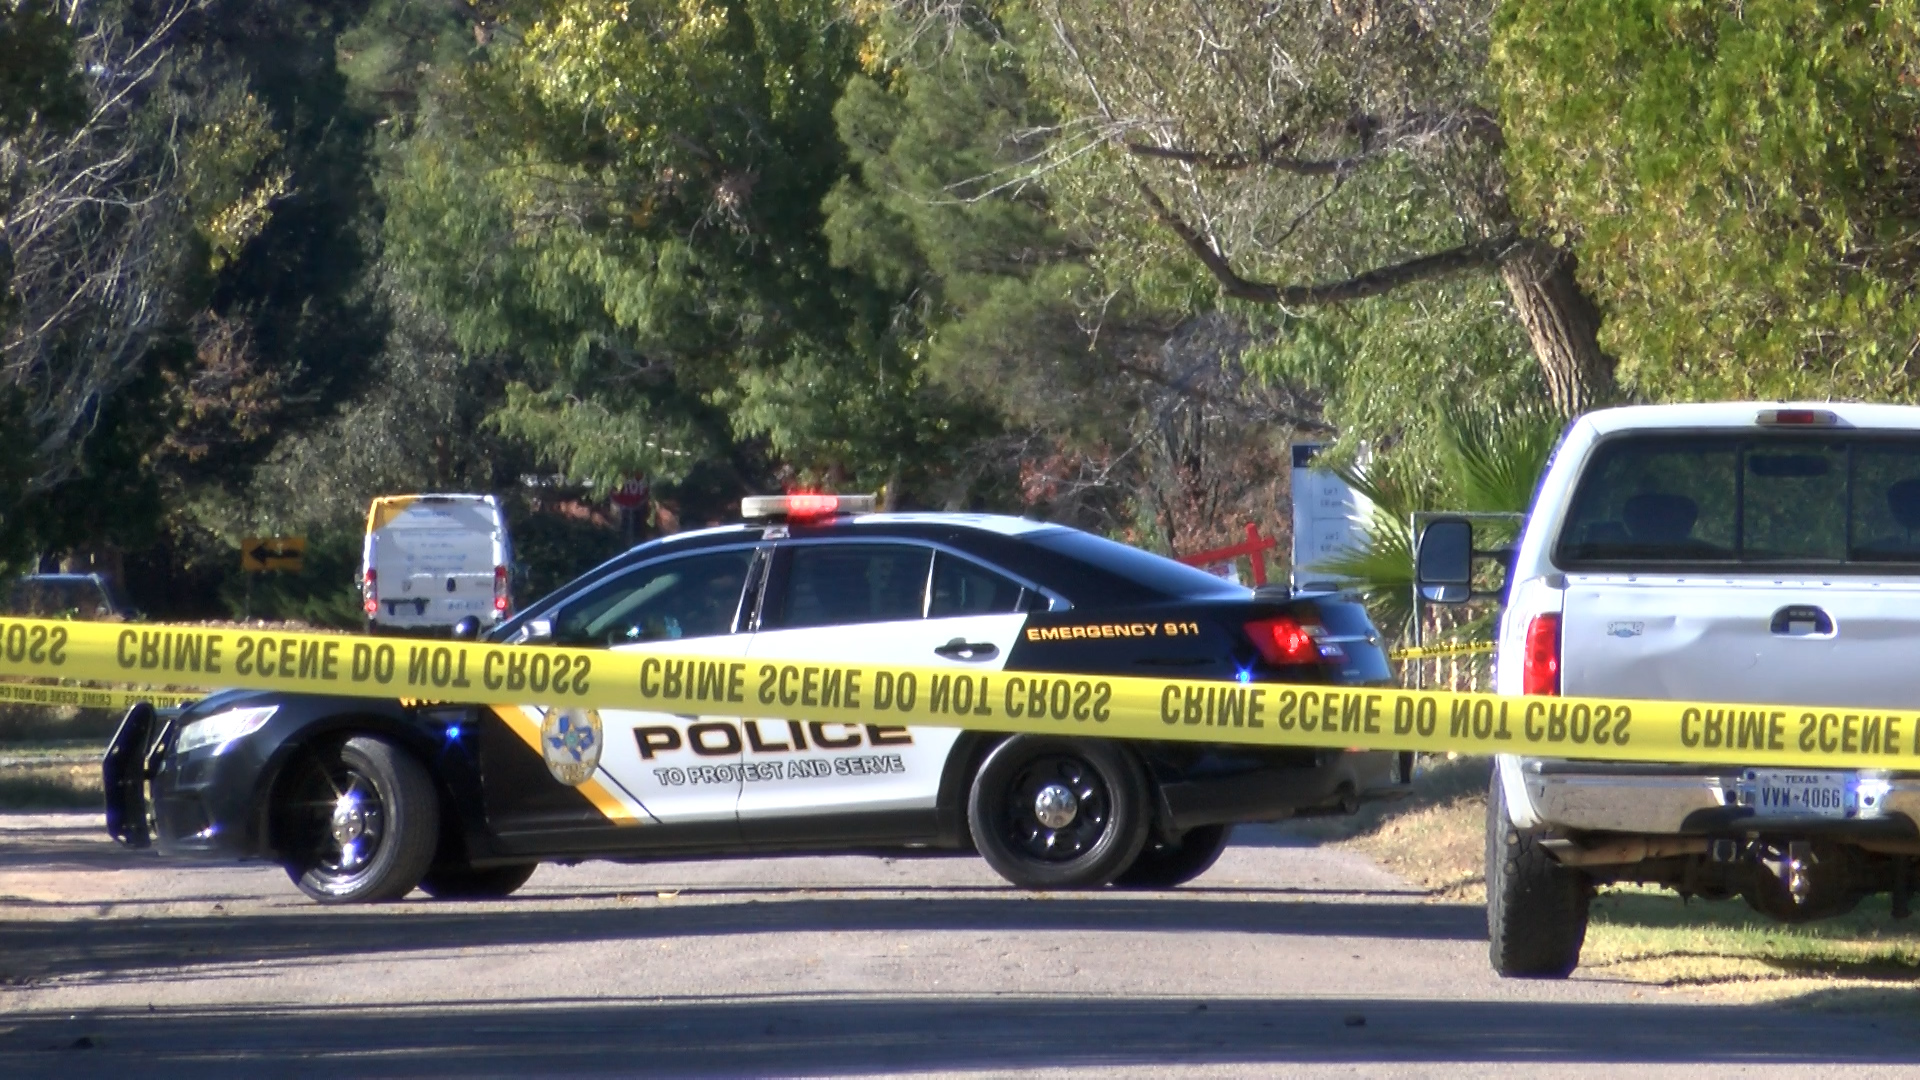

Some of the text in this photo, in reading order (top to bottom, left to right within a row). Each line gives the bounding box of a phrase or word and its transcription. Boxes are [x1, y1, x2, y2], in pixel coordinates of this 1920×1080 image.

[1026, 622, 1199, 641] EMERGENCY 911
[632, 719, 914, 761] POLICE
[654, 754, 905, 786] TO PROTECT AND SERVE
[1785, 775, 1819, 784] TEXAS
